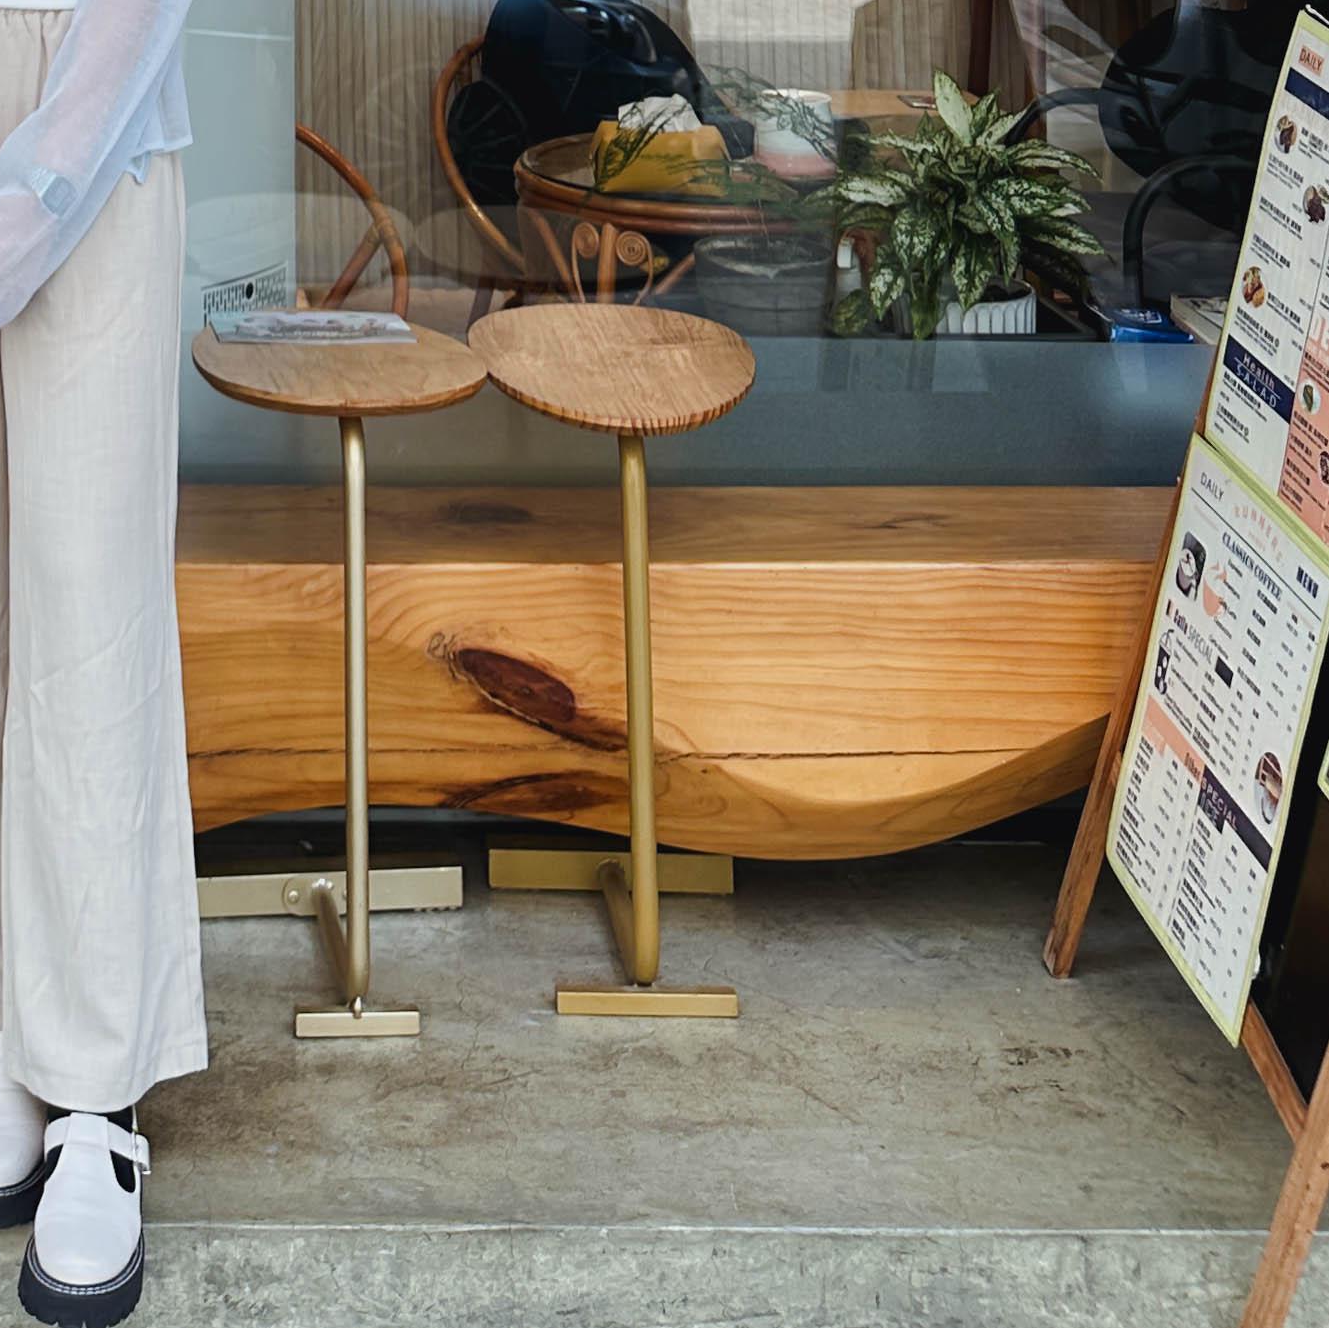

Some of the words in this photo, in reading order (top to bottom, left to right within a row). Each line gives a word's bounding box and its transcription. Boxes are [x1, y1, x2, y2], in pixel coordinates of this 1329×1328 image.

[1298, 45, 1324, 78] DAILY
[1242, 352, 1276, 390] Health
[1199, 471, 1225, 502] DAILY
[1222, 530, 1255, 573] CLASSICS
[1253, 563, 1283, 601] COFFEE
[1295, 565, 1319, 600] MENU
[1201, 776, 1239, 831] SPECIAL
